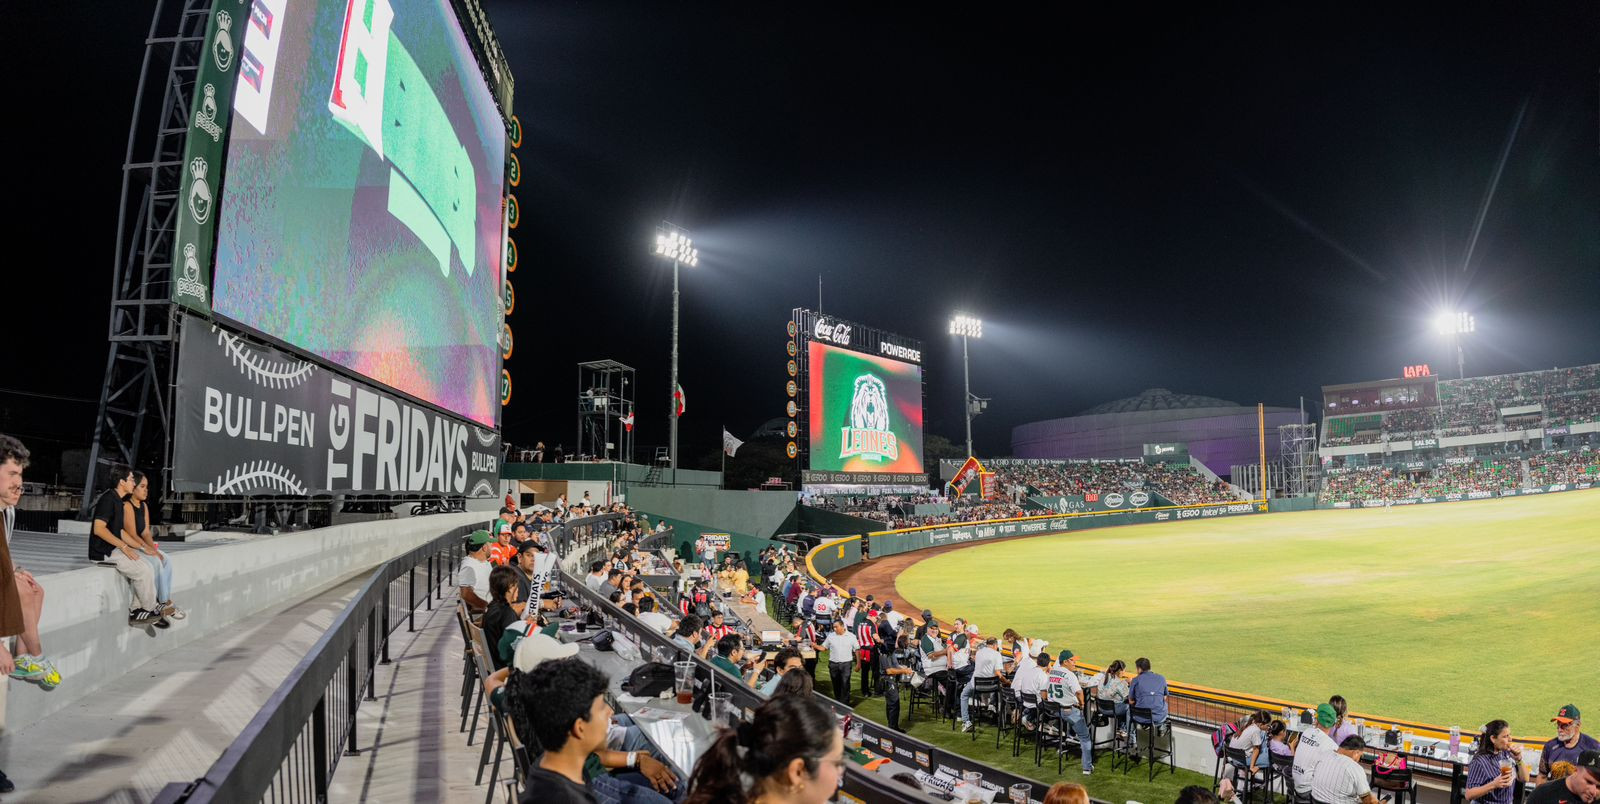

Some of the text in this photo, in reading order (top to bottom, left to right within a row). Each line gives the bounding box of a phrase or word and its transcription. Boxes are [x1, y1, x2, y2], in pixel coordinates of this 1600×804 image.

[881, 342, 921, 362] POWERADE
[1404, 364, 1430, 378] LAPA
[204, 386, 315, 448] BULLPEN
[326, 378, 351, 491] TGI
[352, 387, 469, 494] FRIDAYS
[839, 426, 898, 461] LEONES
[471, 451, 497, 473] BULLPEN
[1069, 501, 1085, 509] GAS
[1182, 509, 1200, 518] G500
[1202, 508, 1219, 517] telcel
[1228, 504, 1253, 512] PERDURA
[529, 573, 541, 616] FRIDAYS
[1048, 683, 1064, 699] 45
